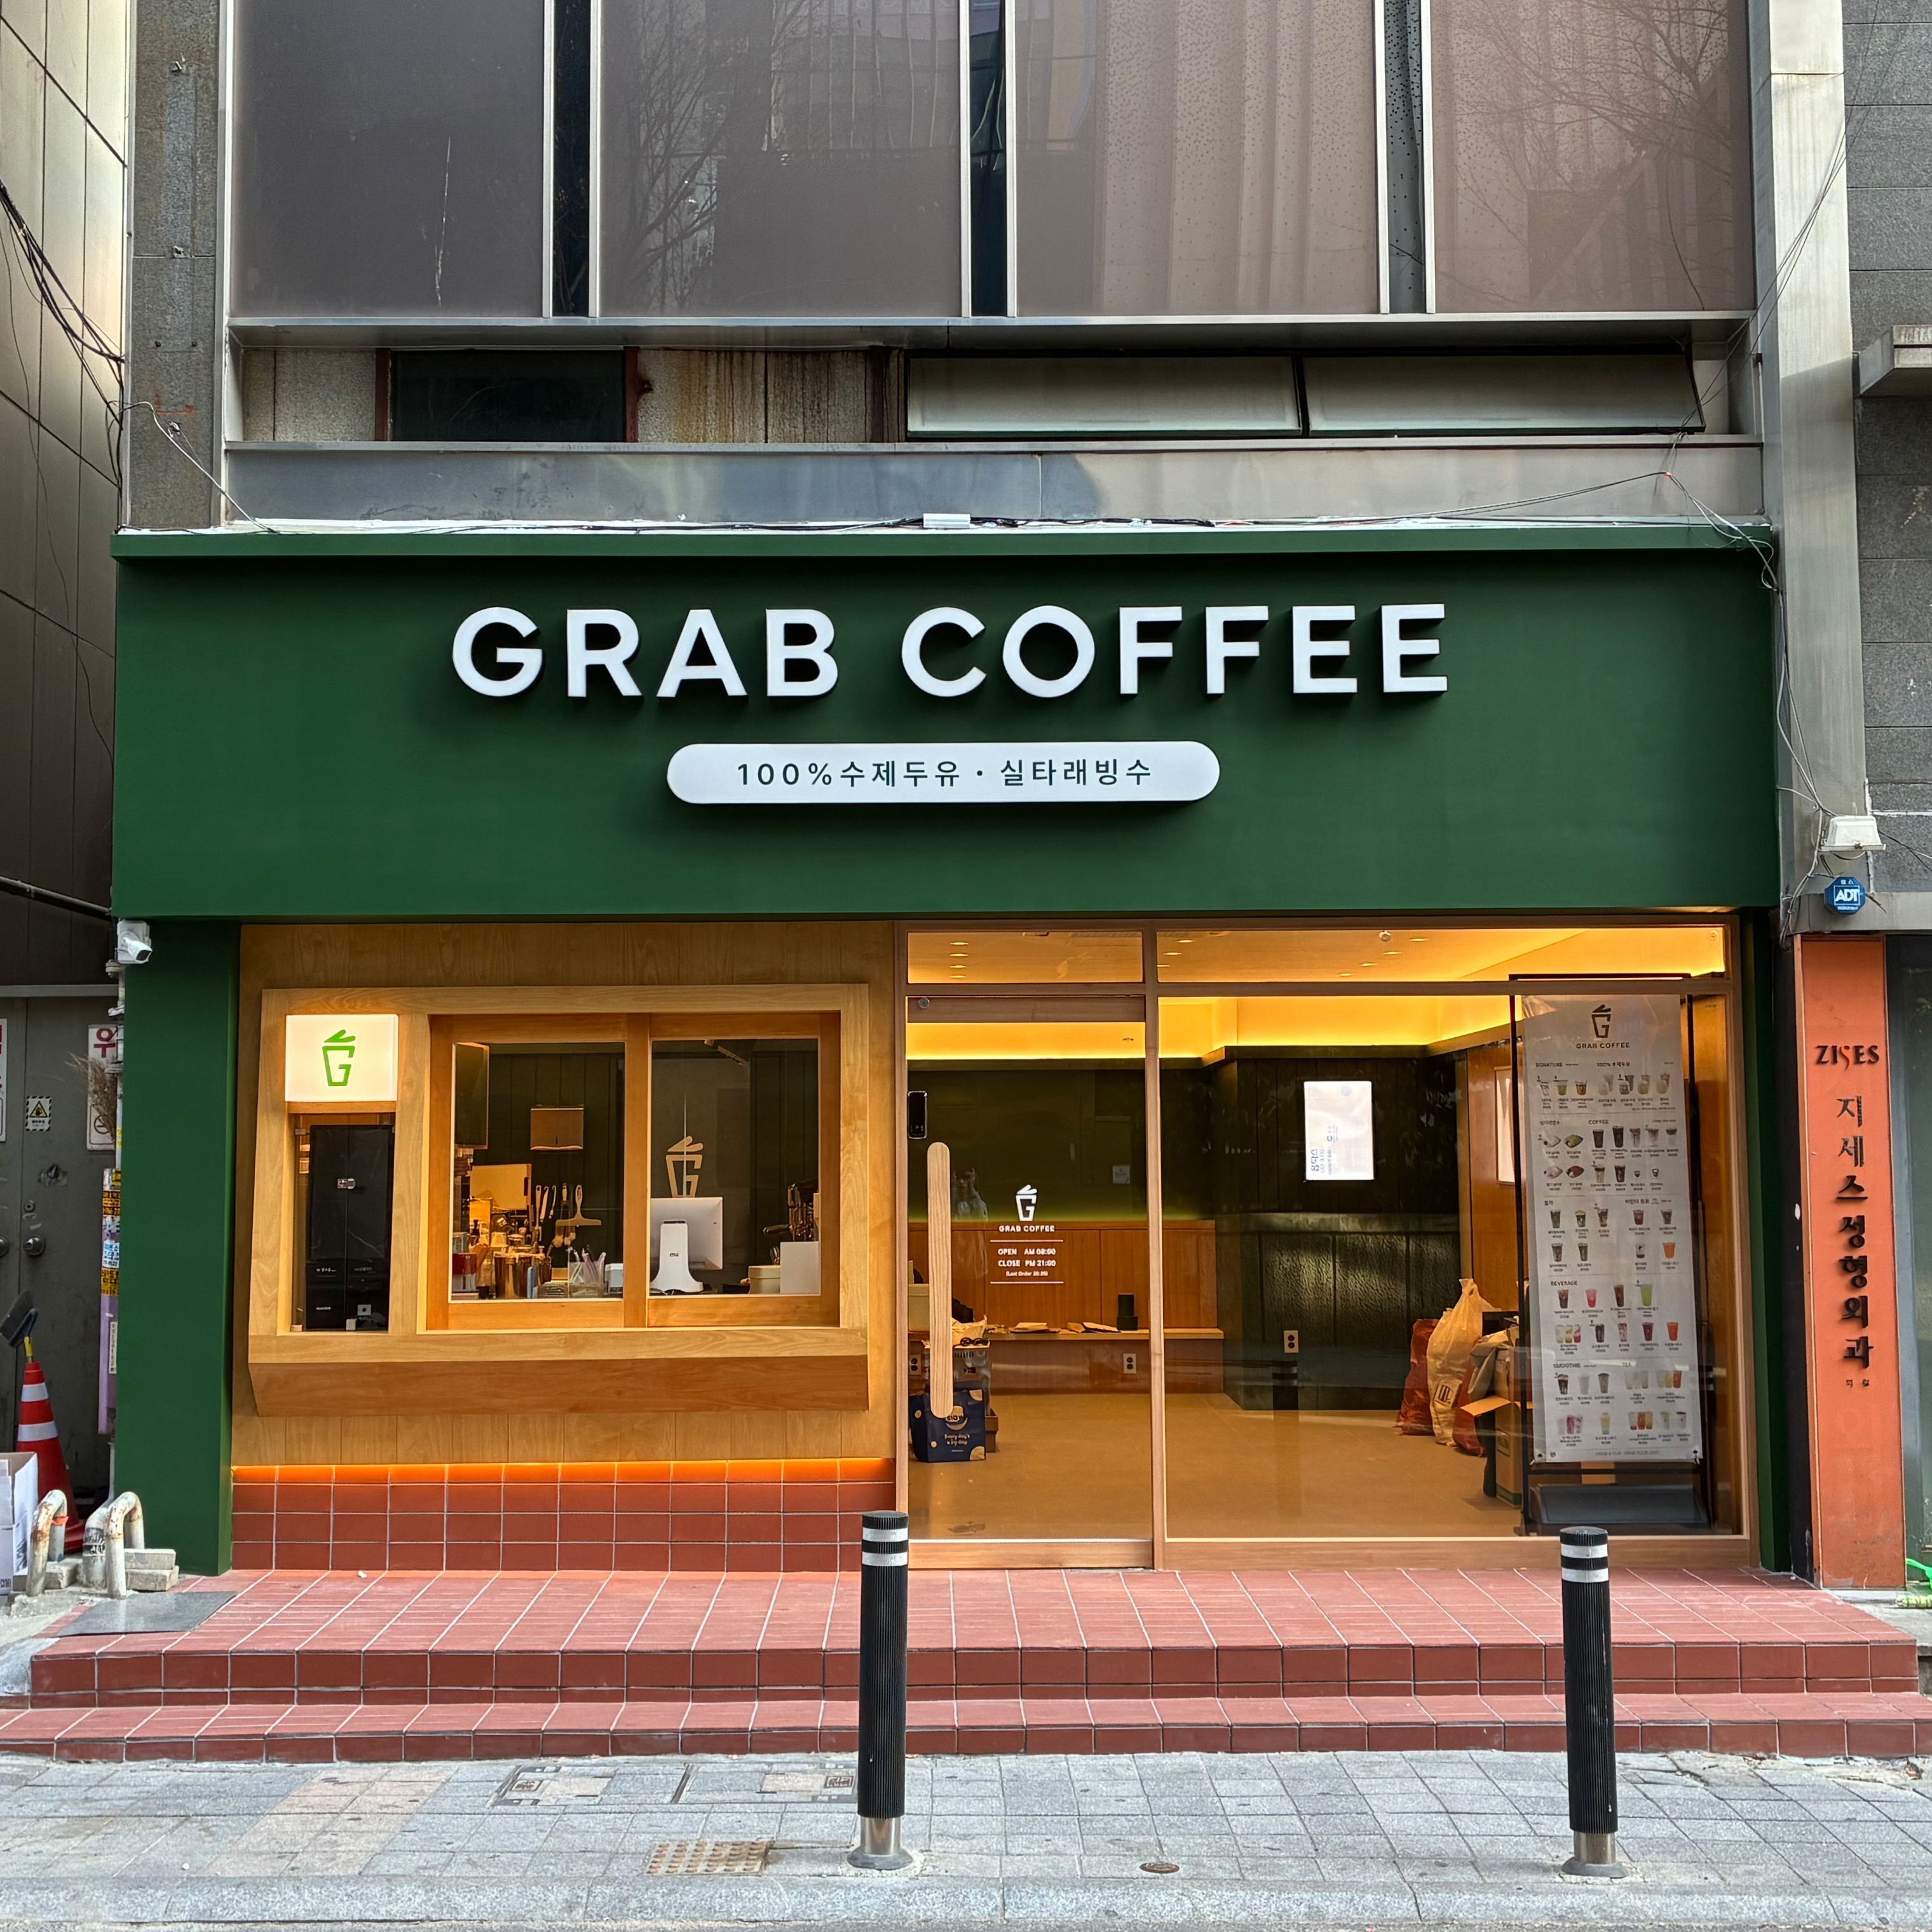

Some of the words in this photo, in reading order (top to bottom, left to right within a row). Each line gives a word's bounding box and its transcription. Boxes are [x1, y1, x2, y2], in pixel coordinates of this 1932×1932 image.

[452, 606, 838, 698] GRAB
[901, 603, 1448, 698] COFFEE
[999, 757, 1152, 787] 실타래빙수
[1835, 888, 1860, 902] ADT
